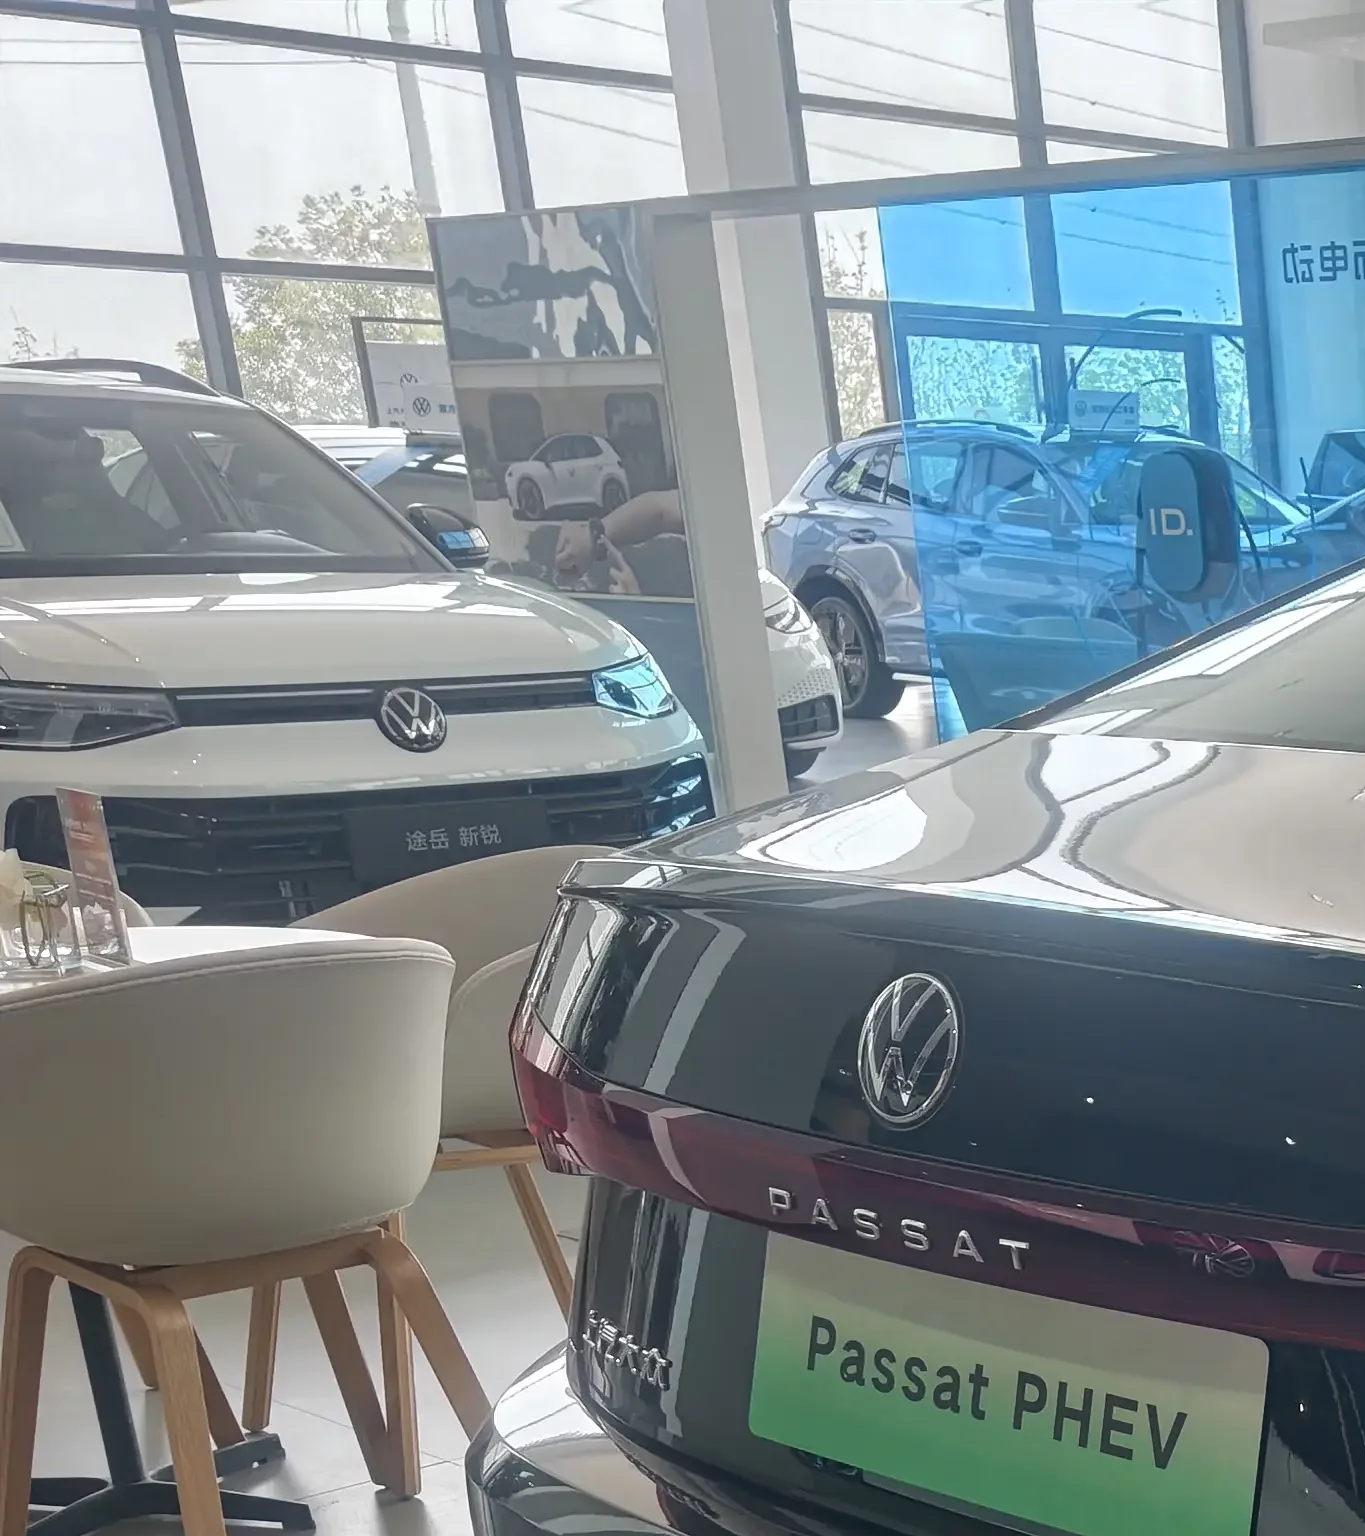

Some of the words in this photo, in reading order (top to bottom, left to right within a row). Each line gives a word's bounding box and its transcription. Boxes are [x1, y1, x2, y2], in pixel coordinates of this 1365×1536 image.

[1149, 508, 1193, 536] ID.
[406, 828, 449, 851] 途岳
[458, 824, 502, 847] 新锐
[768, 1186, 1030, 1271] PASSAT
[806, 1314, 990, 1421] Passat
[1012, 1370, 1188, 1471] PHEV
